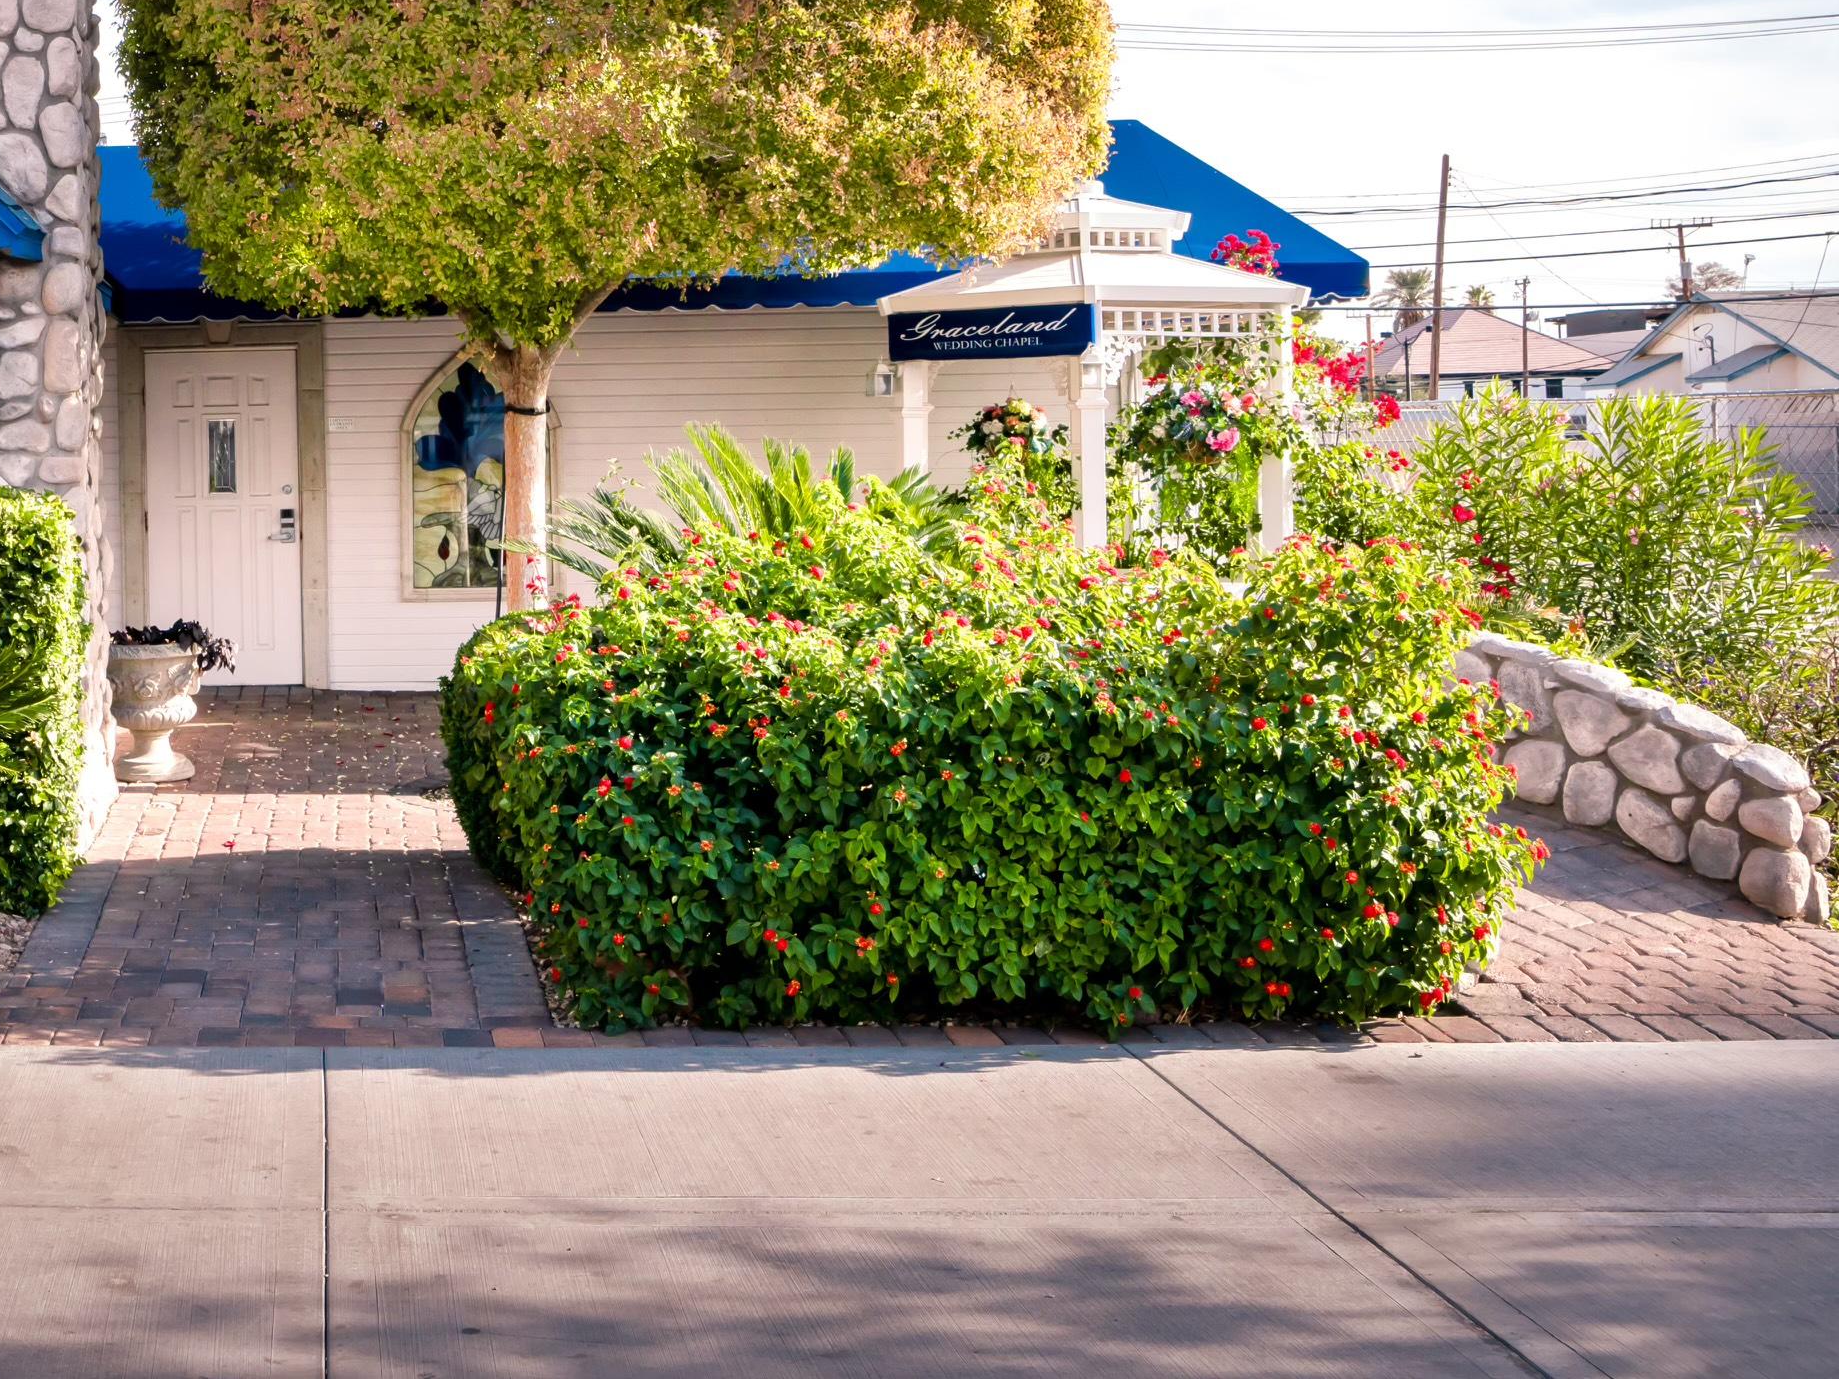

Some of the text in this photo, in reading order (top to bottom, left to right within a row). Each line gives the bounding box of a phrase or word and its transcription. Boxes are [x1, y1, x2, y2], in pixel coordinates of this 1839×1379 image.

[900, 308, 1077, 341] Graceland
[933, 336, 1044, 351] WEDDING CHAPEL
